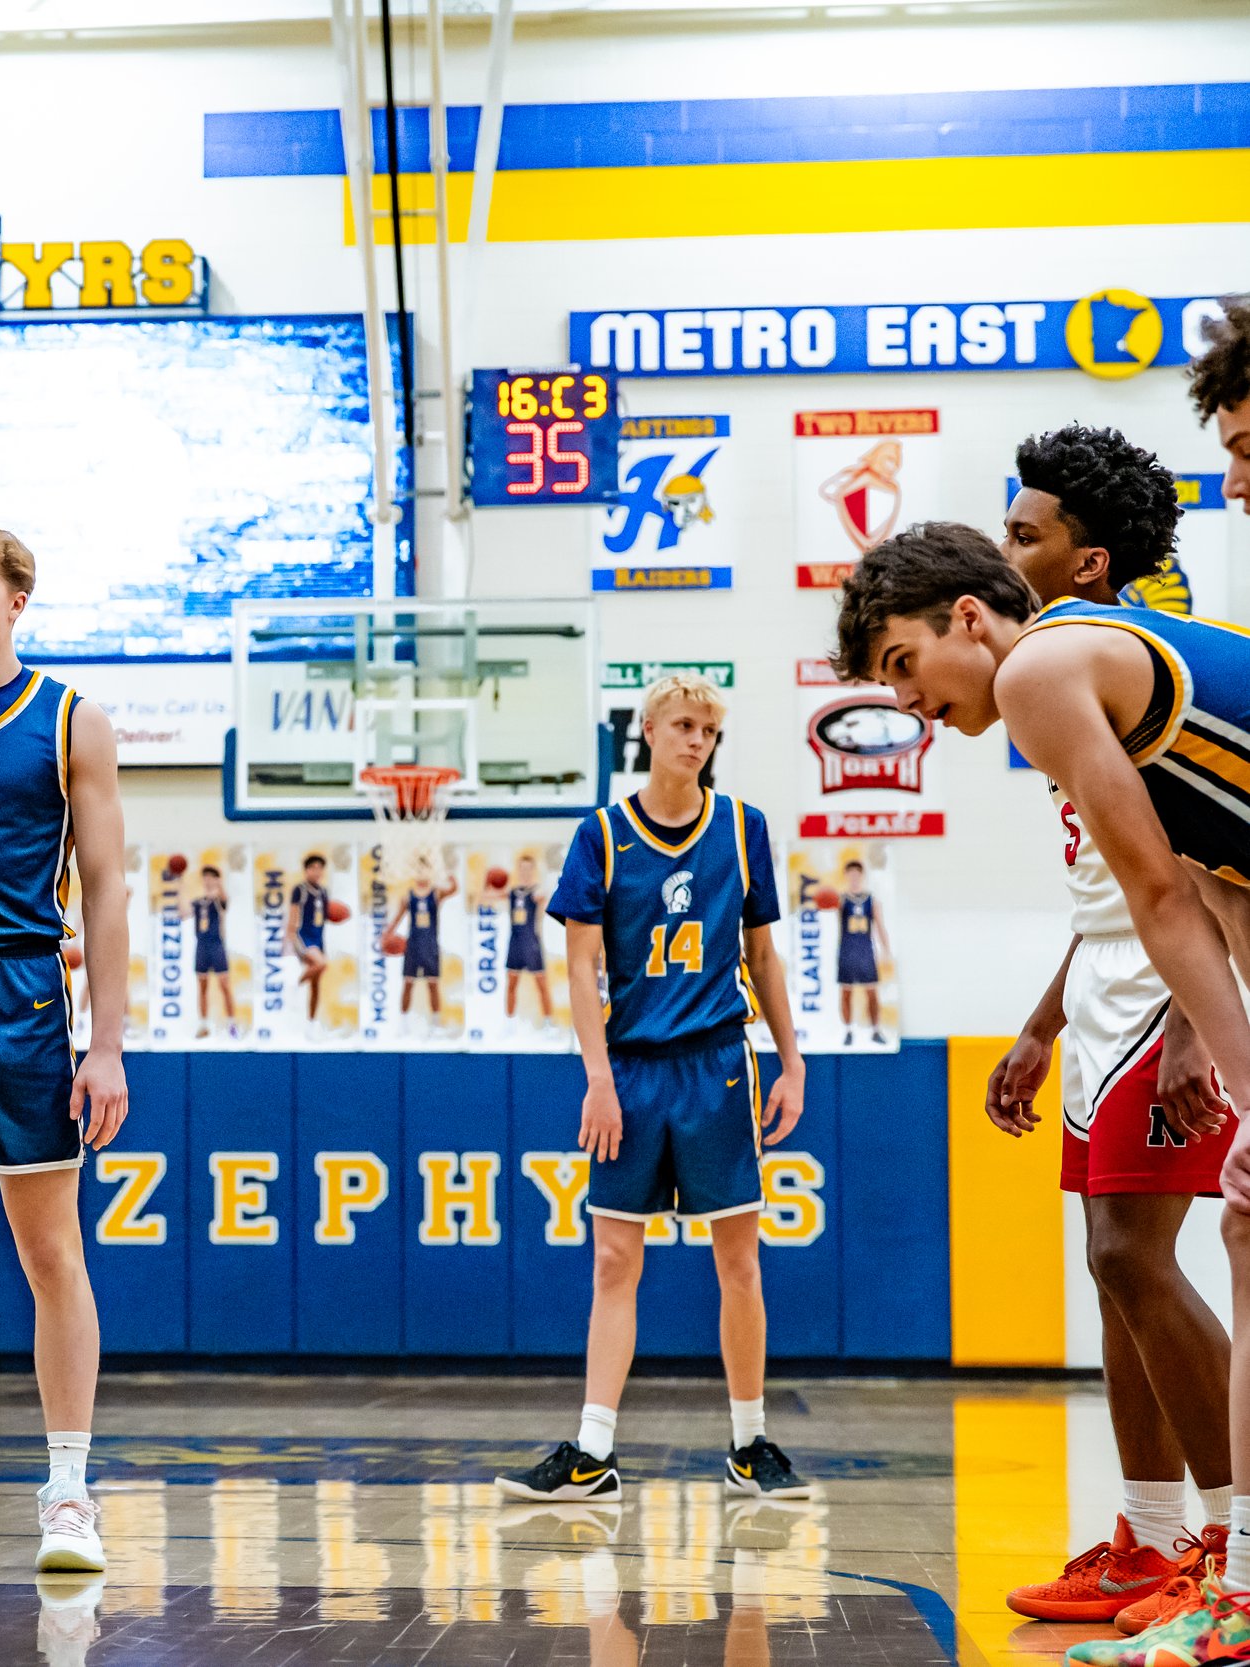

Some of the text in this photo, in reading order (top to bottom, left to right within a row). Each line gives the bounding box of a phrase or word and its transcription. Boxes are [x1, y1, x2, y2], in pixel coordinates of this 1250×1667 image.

[589, 302, 1046, 372] METRO EAST
[506, 421, 589, 494] 35
[264, 870, 285, 1011] SEVENICH
[478, 903, 498, 995] GRAFF
[646, 921, 703, 977] 14
[800, 873, 821, 1013] FLAHERTY
[96, 1151, 827, 1247] ZEPHYS
